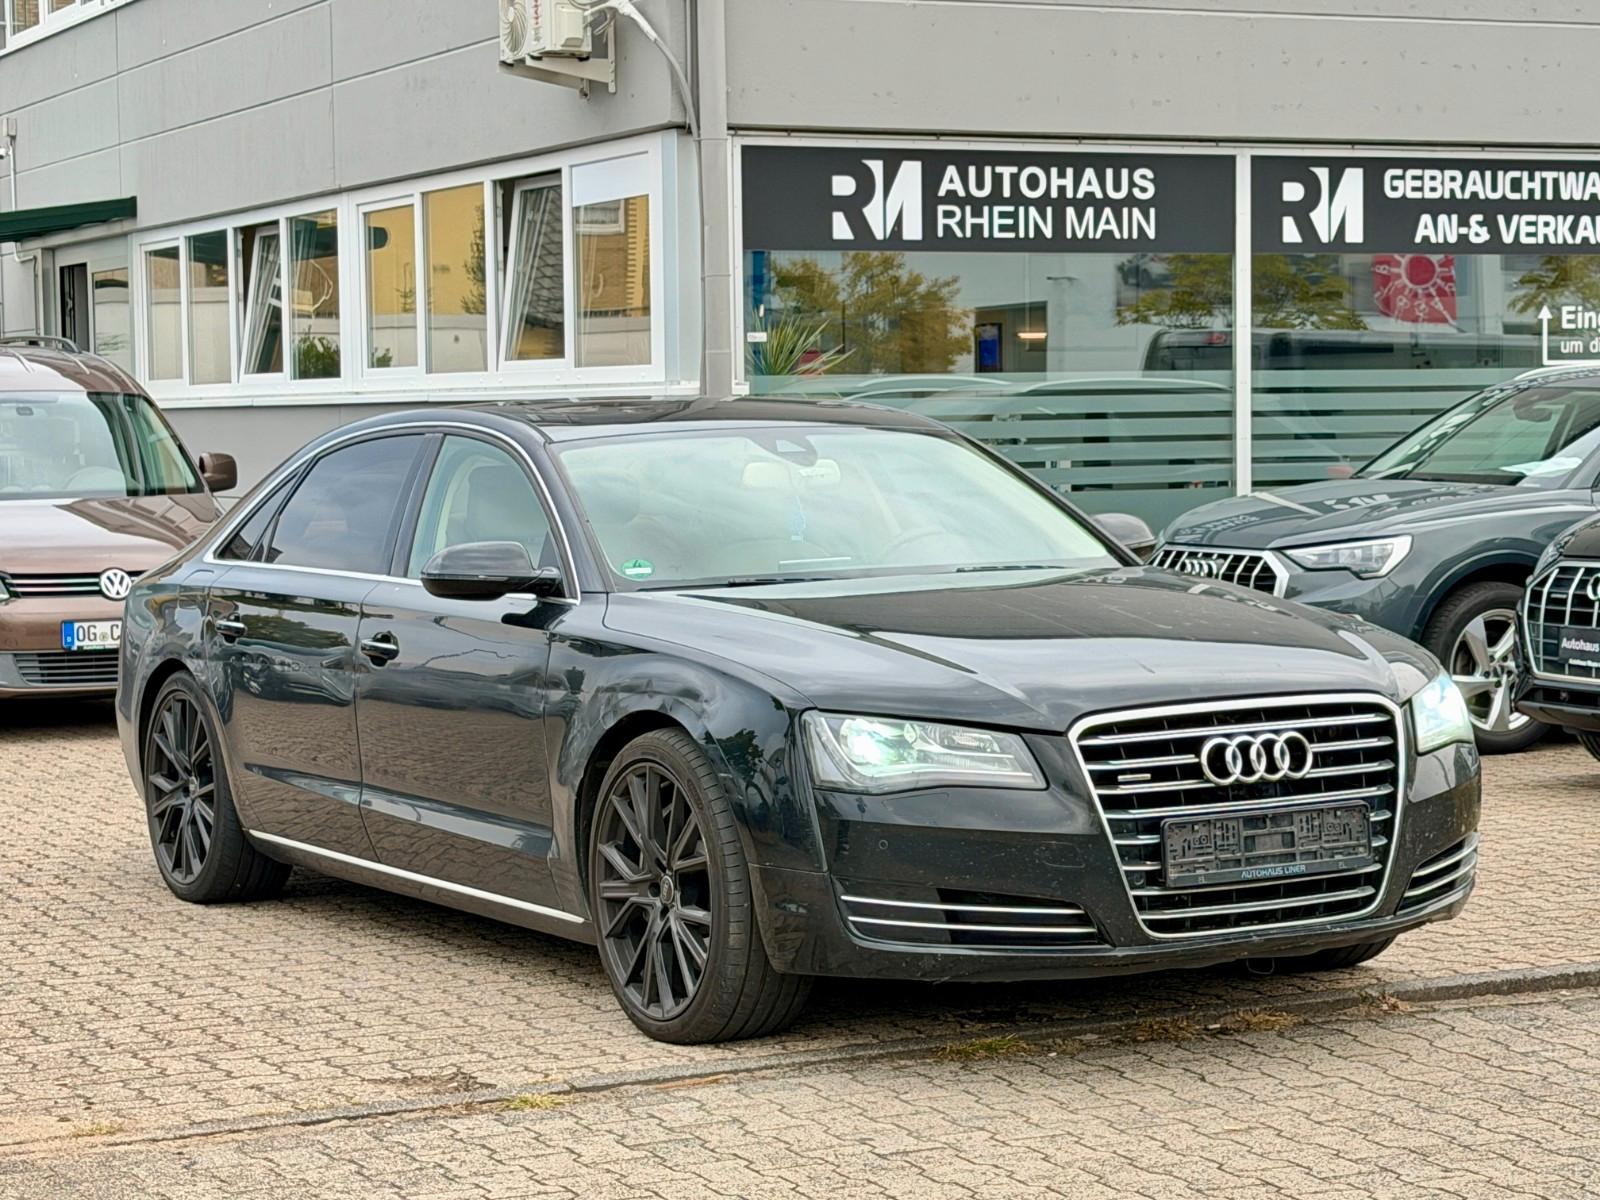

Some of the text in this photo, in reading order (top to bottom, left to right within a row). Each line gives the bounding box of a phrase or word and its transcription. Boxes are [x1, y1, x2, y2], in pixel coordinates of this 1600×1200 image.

[937, 164, 1156, 200] AUTOHAUS
[1383, 168, 1600, 201] GEBRAUCHTWA
[936, 204, 1156, 240] RHEIN MAIN
[1561, 305, 1600, 334] Ein
[1560, 340, 1584, 354] um
[76, 624, 98, 642] OG
[1561, 636, 1600, 652] Autohaus
